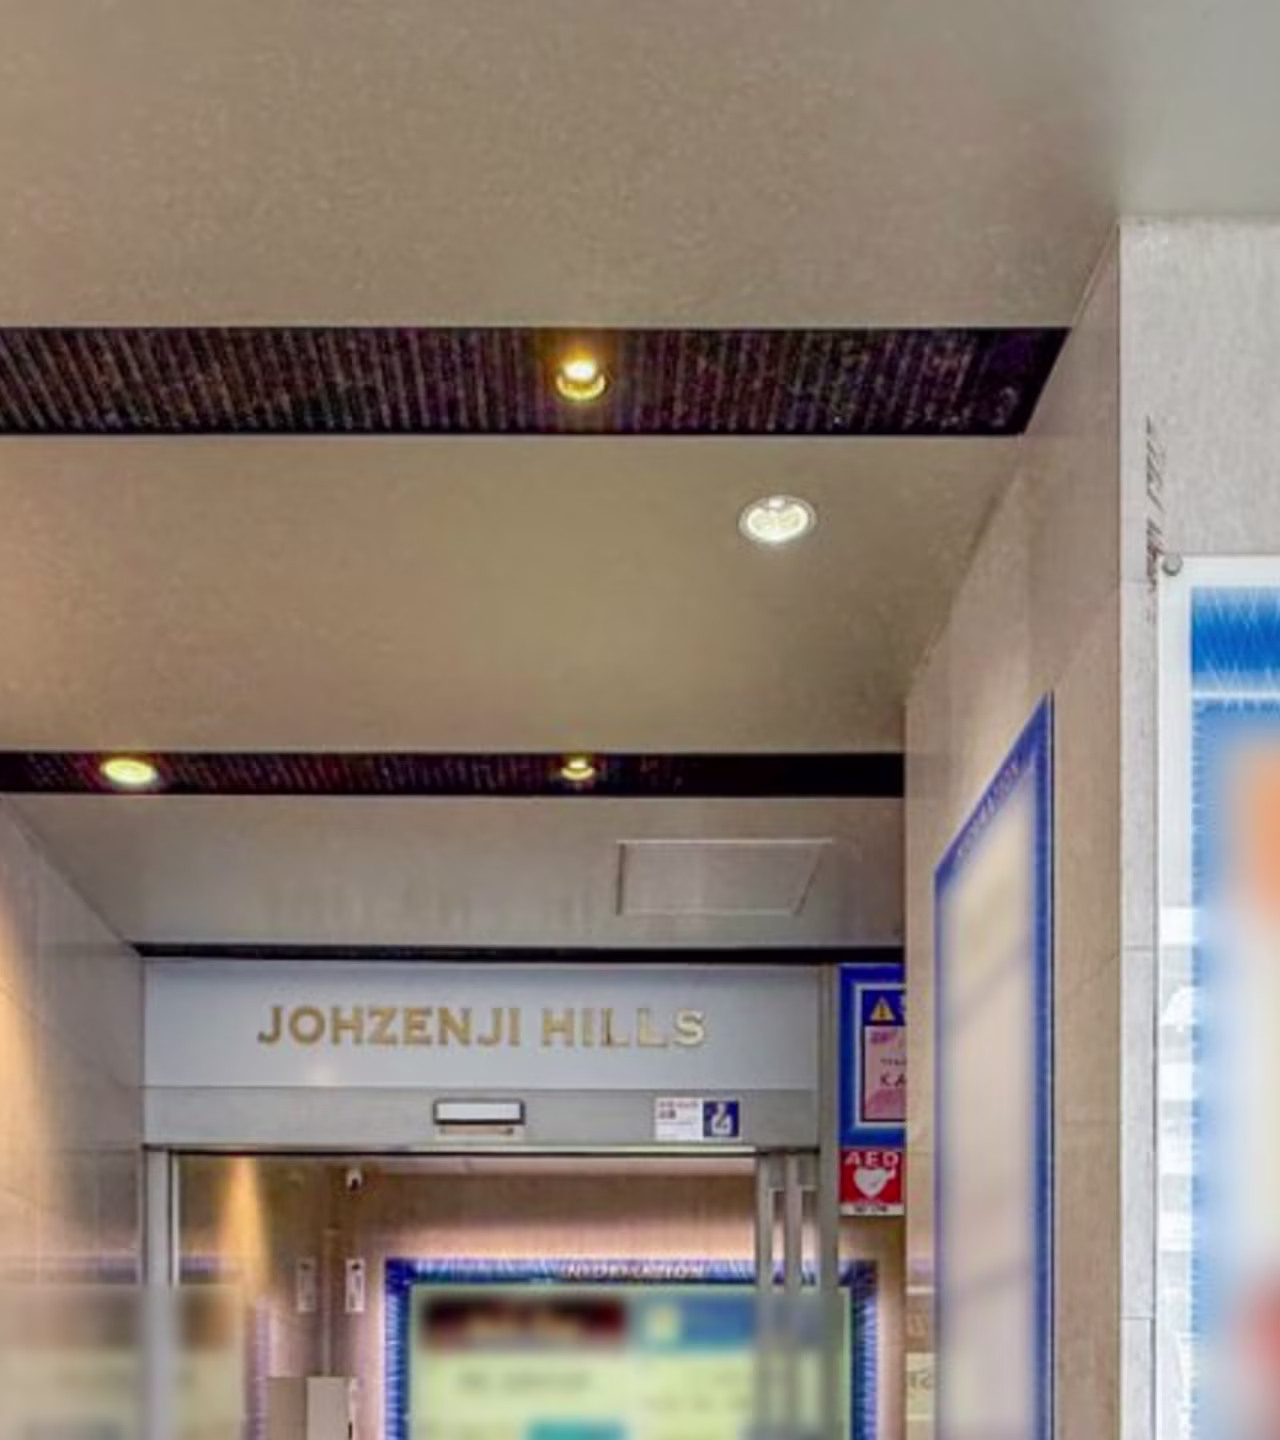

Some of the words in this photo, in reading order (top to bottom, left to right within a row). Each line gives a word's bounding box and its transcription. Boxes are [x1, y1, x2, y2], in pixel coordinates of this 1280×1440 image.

[257, 1005, 520, 1047] JOHZENJI
[541, 1007, 706, 1049] HILLS
[844, 1150, 899, 1168] AED
